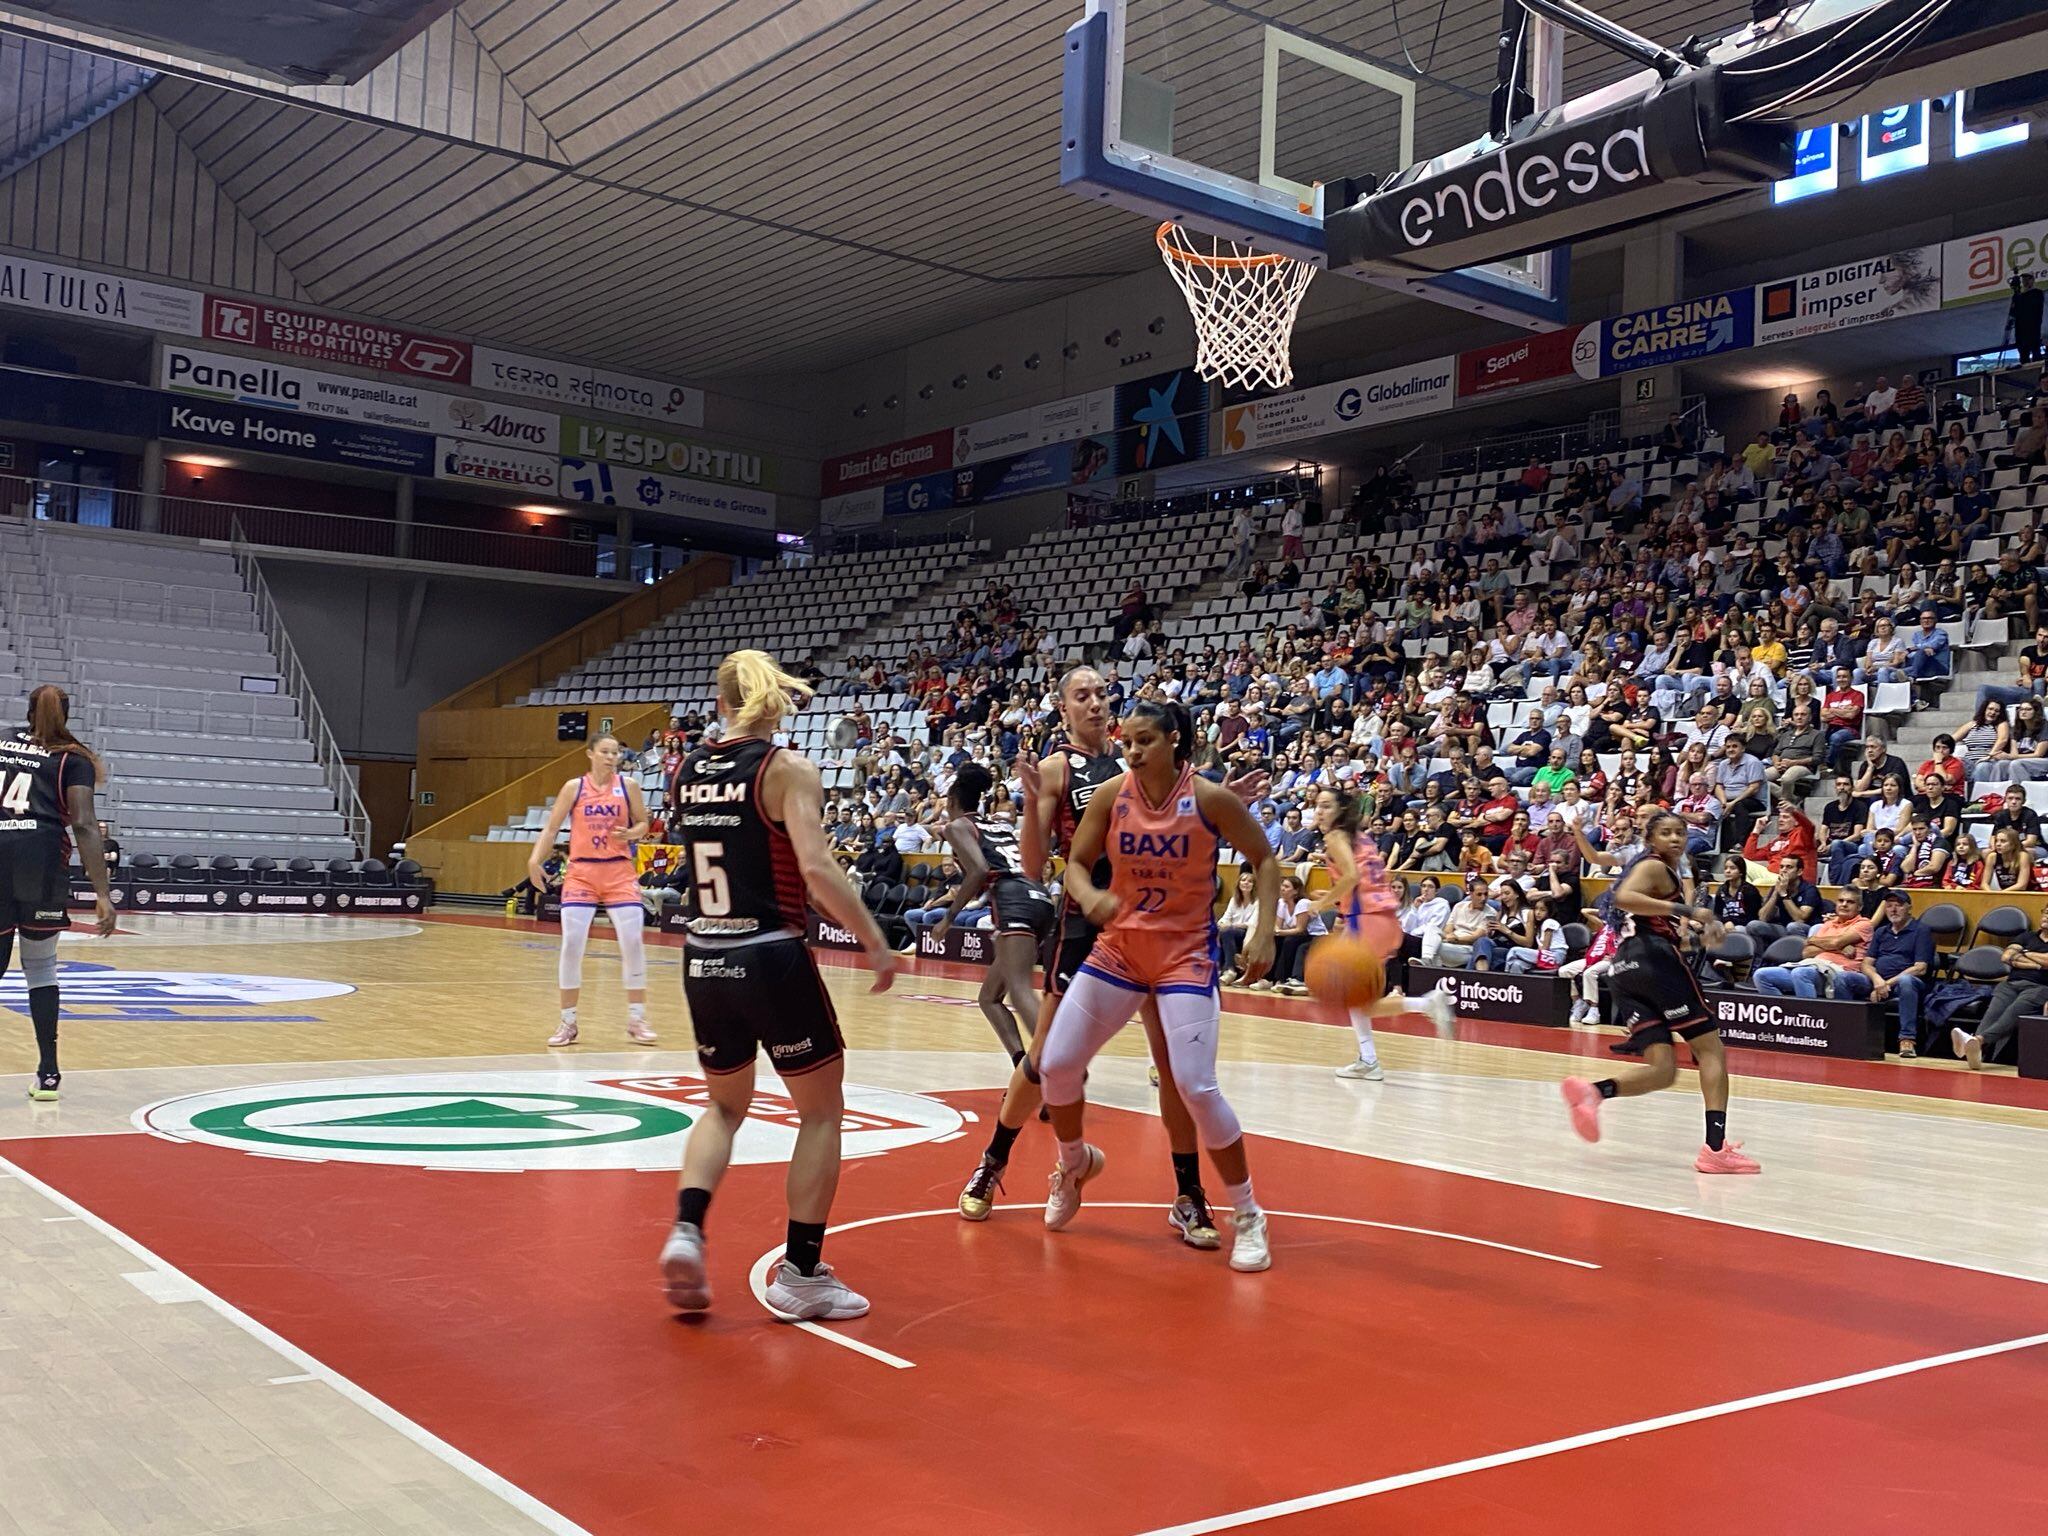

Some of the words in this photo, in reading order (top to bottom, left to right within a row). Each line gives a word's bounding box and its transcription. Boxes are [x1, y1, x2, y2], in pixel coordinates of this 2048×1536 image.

[1400, 125, 1650, 246] endesa
[1802, 275, 1819, 291] La
[1826, 259, 1895, 286] DIGITAL
[42, 272, 127, 319] TULSÀ
[1801, 286, 1877, 317] impser
[264, 309, 402, 347] EQUIPACIONS
[1612, 296, 1733, 339] CALSINA
[1761, 329, 1794, 342] serveis
[1795, 320, 1837, 335] integrals
[272, 326, 394, 360] ESPORTIVES
[1486, 343, 1529, 374] Servei
[169, 354, 300, 400] Panella
[1367, 373, 1451, 403] Globalimar
[317, 382, 418, 408] www.panella.cat
[1257, 394, 1306, 411] Prevenció
[171, 407, 235, 435] Kave
[243, 418, 317, 448] Home
[1257, 407, 1294, 420] Laboral
[1290, 415, 1308, 424] SLU
[480, 414, 546, 444] Abras
[578, 426, 762, 485] L'ESPORTIU
[839, 456, 870, 481] Diari
[872, 453, 888, 473] de
[890, 444, 934, 469] Girona
[714, 498, 727, 509] de
[730, 501, 768, 516] Girona
[680, 782, 747, 804] HOLM
[584, 804, 621, 817] BAXI
[1120, 832, 1189, 858] BAXI
[693, 841, 732, 917] 5
[1136, 887, 1168, 913] 22
[963, 932, 981, 950] ibis
[1460, 980, 1523, 1004] infosoft
[1737, 1003, 1783, 1025] MGC
[1757, 1032, 1775, 1043] dels
[1775, 1034, 1829, 1048] Mutualistes
